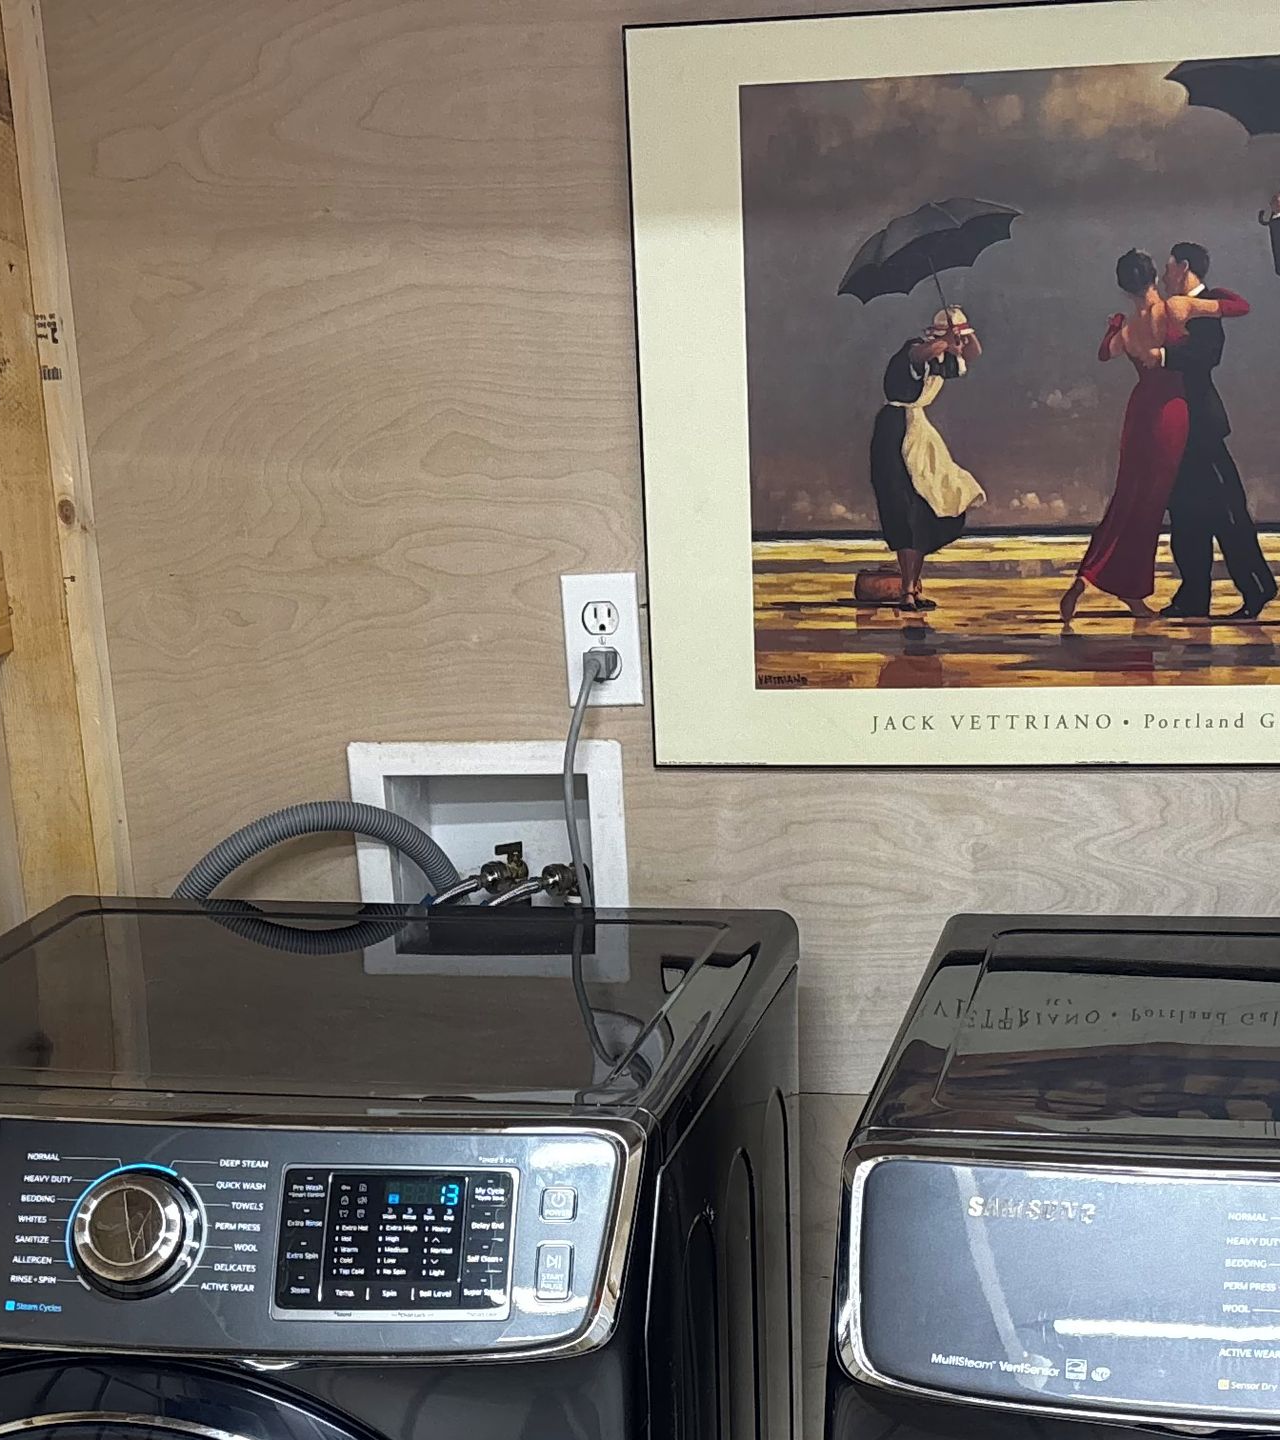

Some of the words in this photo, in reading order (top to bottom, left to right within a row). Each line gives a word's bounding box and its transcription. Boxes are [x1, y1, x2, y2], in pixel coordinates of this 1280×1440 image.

[871, 715, 936, 734] JACK
[950, 714, 1113, 731] VETTRIANO
[1144, 713, 1245, 729] Portland
[27, 1153, 60, 1161] NORMAL
[220, 1159, 241, 1167] DEEP
[242, 1160, 269, 1168] STEAM
[23, 1175, 50, 1183] HEAVY
[216, 1181, 241, 1190] QUICK
[242, 1182, 267, 1190] WASH
[475, 1187, 486, 1195] My
[21, 1194, 55, 1203] BEDDING
[231, 1201, 264, 1210] TOWELS
[18, 1215, 47, 1223] WHITES
[1228, 1212, 1268, 1221] NORMAL
[215, 1222, 236, 1230] PERM
[237, 1223, 261, 1231] PRESS
[15, 1235, 49, 1244] SANITIZE
[1226, 1237, 1258, 1246] HEAVY
[234, 1243, 258, 1252] WOOL
[12, 1256, 52, 1264] ALLERGEN
[304, 1252, 319, 1260] Spin
[214, 1263, 256, 1272] DELICATES
[1225, 1259, 1267, 1268] BEDDING
[10, 1275, 33, 1283] RINSE
[38, 1276, 57, 1284] SPIN
[200, 1283, 229, 1291] ACTIVE
[231, 1284, 255, 1292] WEAR
[1223, 1281, 1248, 1291] PERM
[1249, 1282, 1277, 1292] PRESS
[1222, 1304, 1251, 1313] WOOL
[1219, 1348, 1252, 1358] ACTIVE
[999, 1360, 1060, 1376] VentSensor
[1231, 1381, 1260, 1390] Sensor
[1261, 1382, 1278, 1392] Dry
